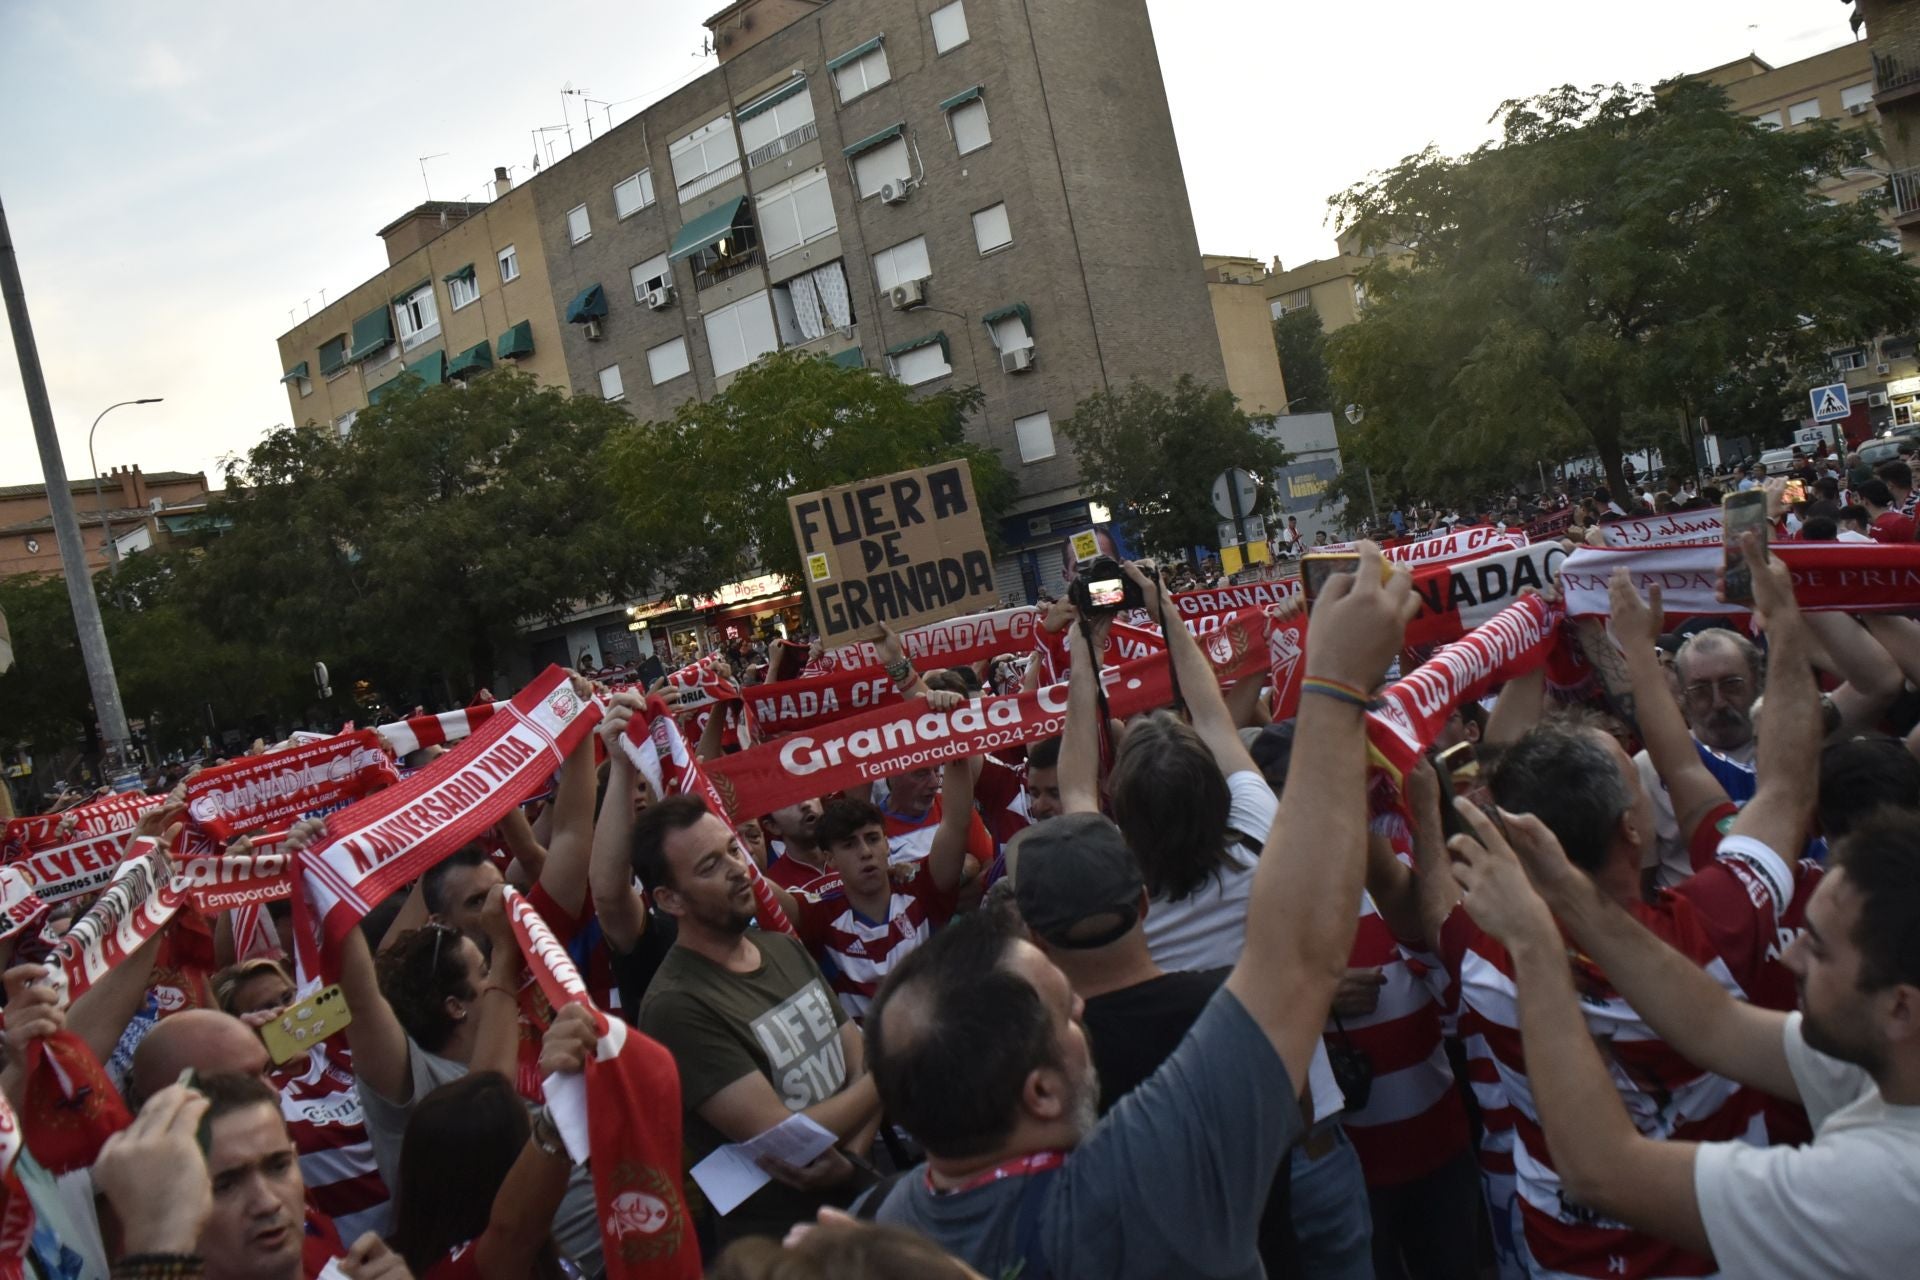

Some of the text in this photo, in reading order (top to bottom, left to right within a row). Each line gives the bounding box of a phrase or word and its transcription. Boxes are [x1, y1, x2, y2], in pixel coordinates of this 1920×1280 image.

[1802, 431, 1824, 441] GLS
[796, 468, 968, 553] FUERA
[861, 532, 909, 573] DE
[1383, 537, 1458, 563] ANADA
[735, 581, 766, 597] Pibes
[816, 550, 993, 636] GRANADA
[1412, 556, 1543, 617] NADA
[836, 618, 997, 672] GRNADA
[1399, 663, 1450, 718] LOS
[779, 697, 1024, 777] Granada
[856, 715, 1067, 779] Temporada 2024-202
[189, 761, 319, 823] GRANADA
[366, 766, 491, 863] ANIVERSARIO
[482, 734, 536, 795] YNDA
[36, 877, 92, 899] GUIREMOS
[756, 991, 832, 1069] LIFE
